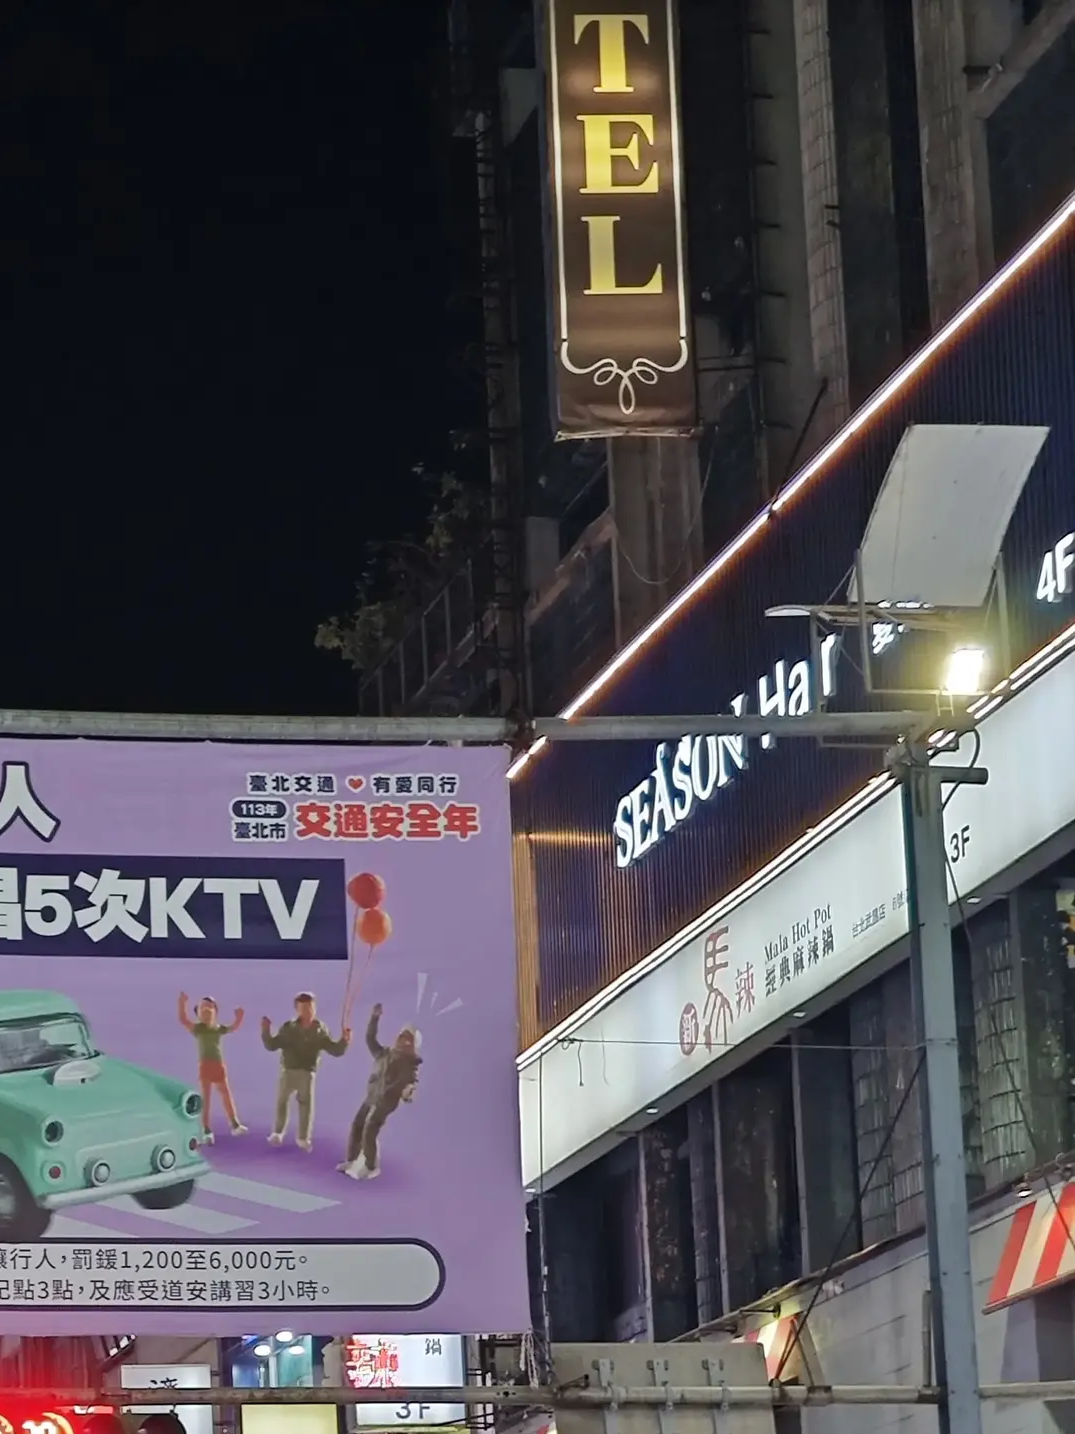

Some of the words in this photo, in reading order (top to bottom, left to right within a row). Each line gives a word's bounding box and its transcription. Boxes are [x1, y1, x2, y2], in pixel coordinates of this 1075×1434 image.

[573, 14, 663, 295] TEL
[1036, 531, 1075, 603] 4F
[759, 632, 838, 749] Har
[249, 774, 337, 794] 臺北交通
[372, 775, 458, 794] 有愛同行
[240, 802, 279, 817] 113年
[295, 803, 479, 839] 交通安全年
[233, 821, 287, 840] 臺北市
[950, 824, 971, 864] 3F
[764, 934, 788, 963] Mala
[791, 916, 810, 945] Hot
[813, 902, 831, 929] Pot
